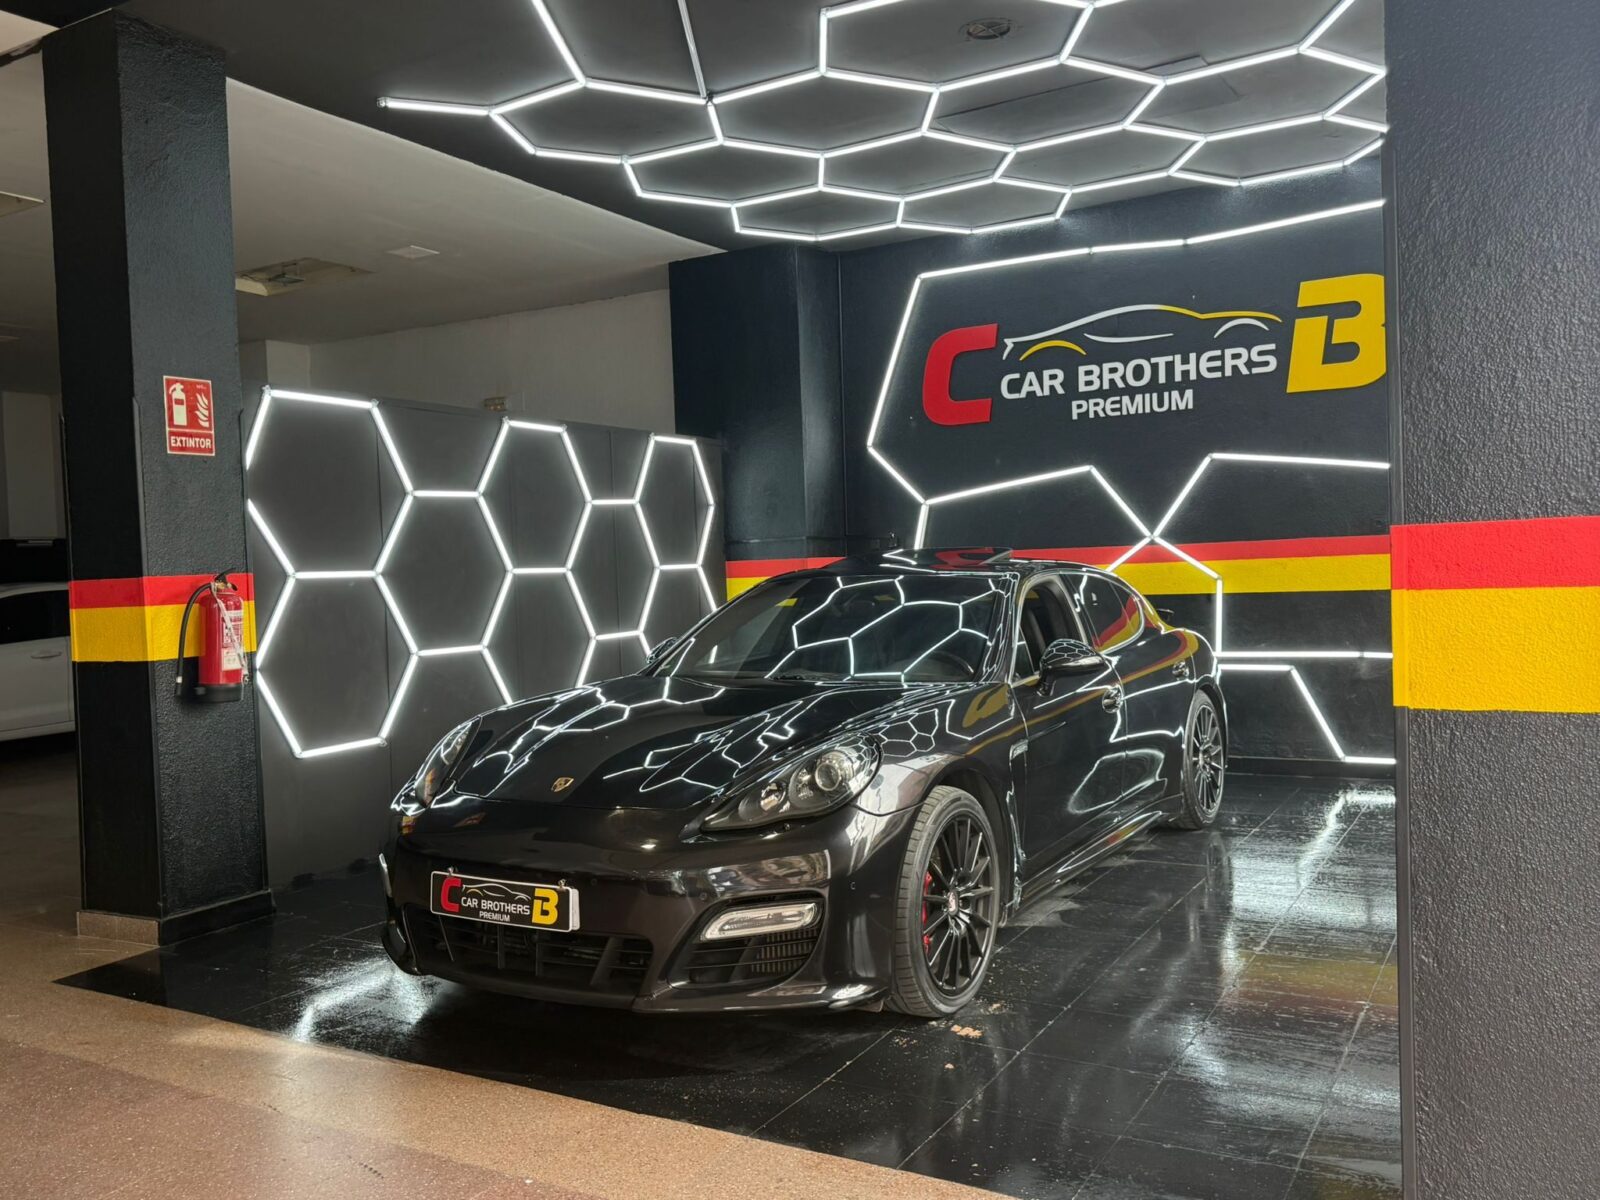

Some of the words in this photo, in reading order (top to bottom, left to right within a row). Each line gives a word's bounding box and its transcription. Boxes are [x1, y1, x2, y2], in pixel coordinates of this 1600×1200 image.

[1286, 273, 1387, 394] B
[922, 323, 997, 425] C
[1000, 368, 1065, 400] CAR
[1078, 343, 1277, 392] BROTHERS
[1071, 389, 1194, 420] PREMIUM
[171, 436, 211, 448] EXTINTOR
[441, 877, 461, 912] C
[461, 896, 478, 908] CAR
[481, 900, 530, 915] BROTHERS
[532, 887, 558, 924] B
[479, 911, 510, 922] PREMIUM
